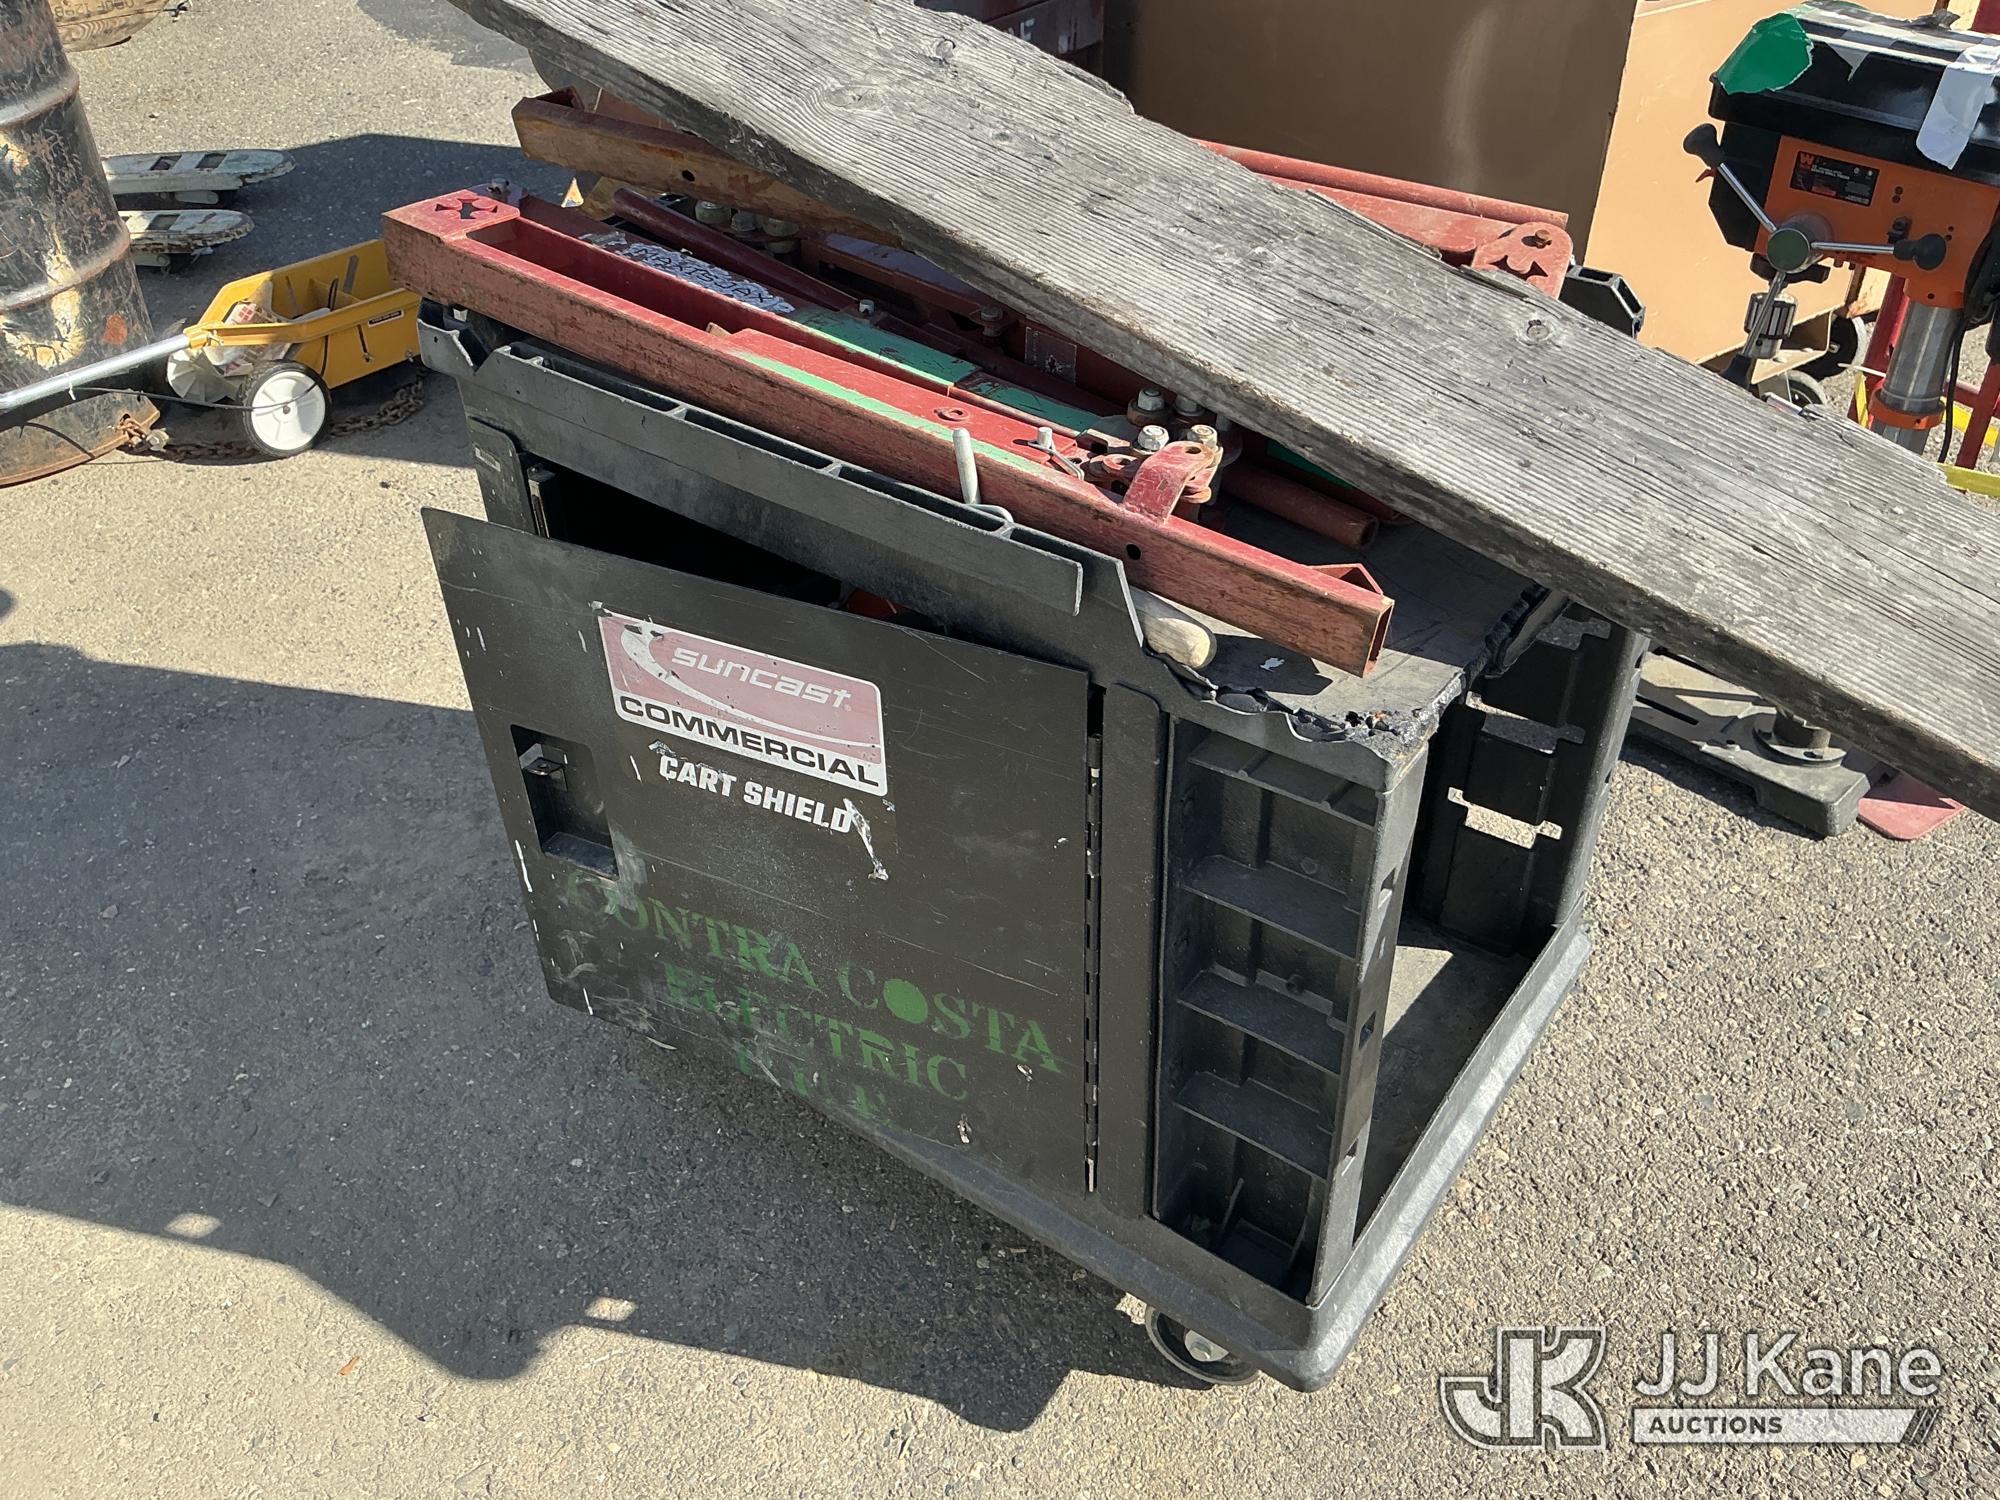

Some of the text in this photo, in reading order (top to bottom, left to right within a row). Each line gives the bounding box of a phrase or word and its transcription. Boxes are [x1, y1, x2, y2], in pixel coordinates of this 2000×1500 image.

[619, 695, 880, 787] COMMERCIAL
[659, 755, 852, 833] CART SHIELD
[565, 868, 1065, 1074] CONTRA COSTA
